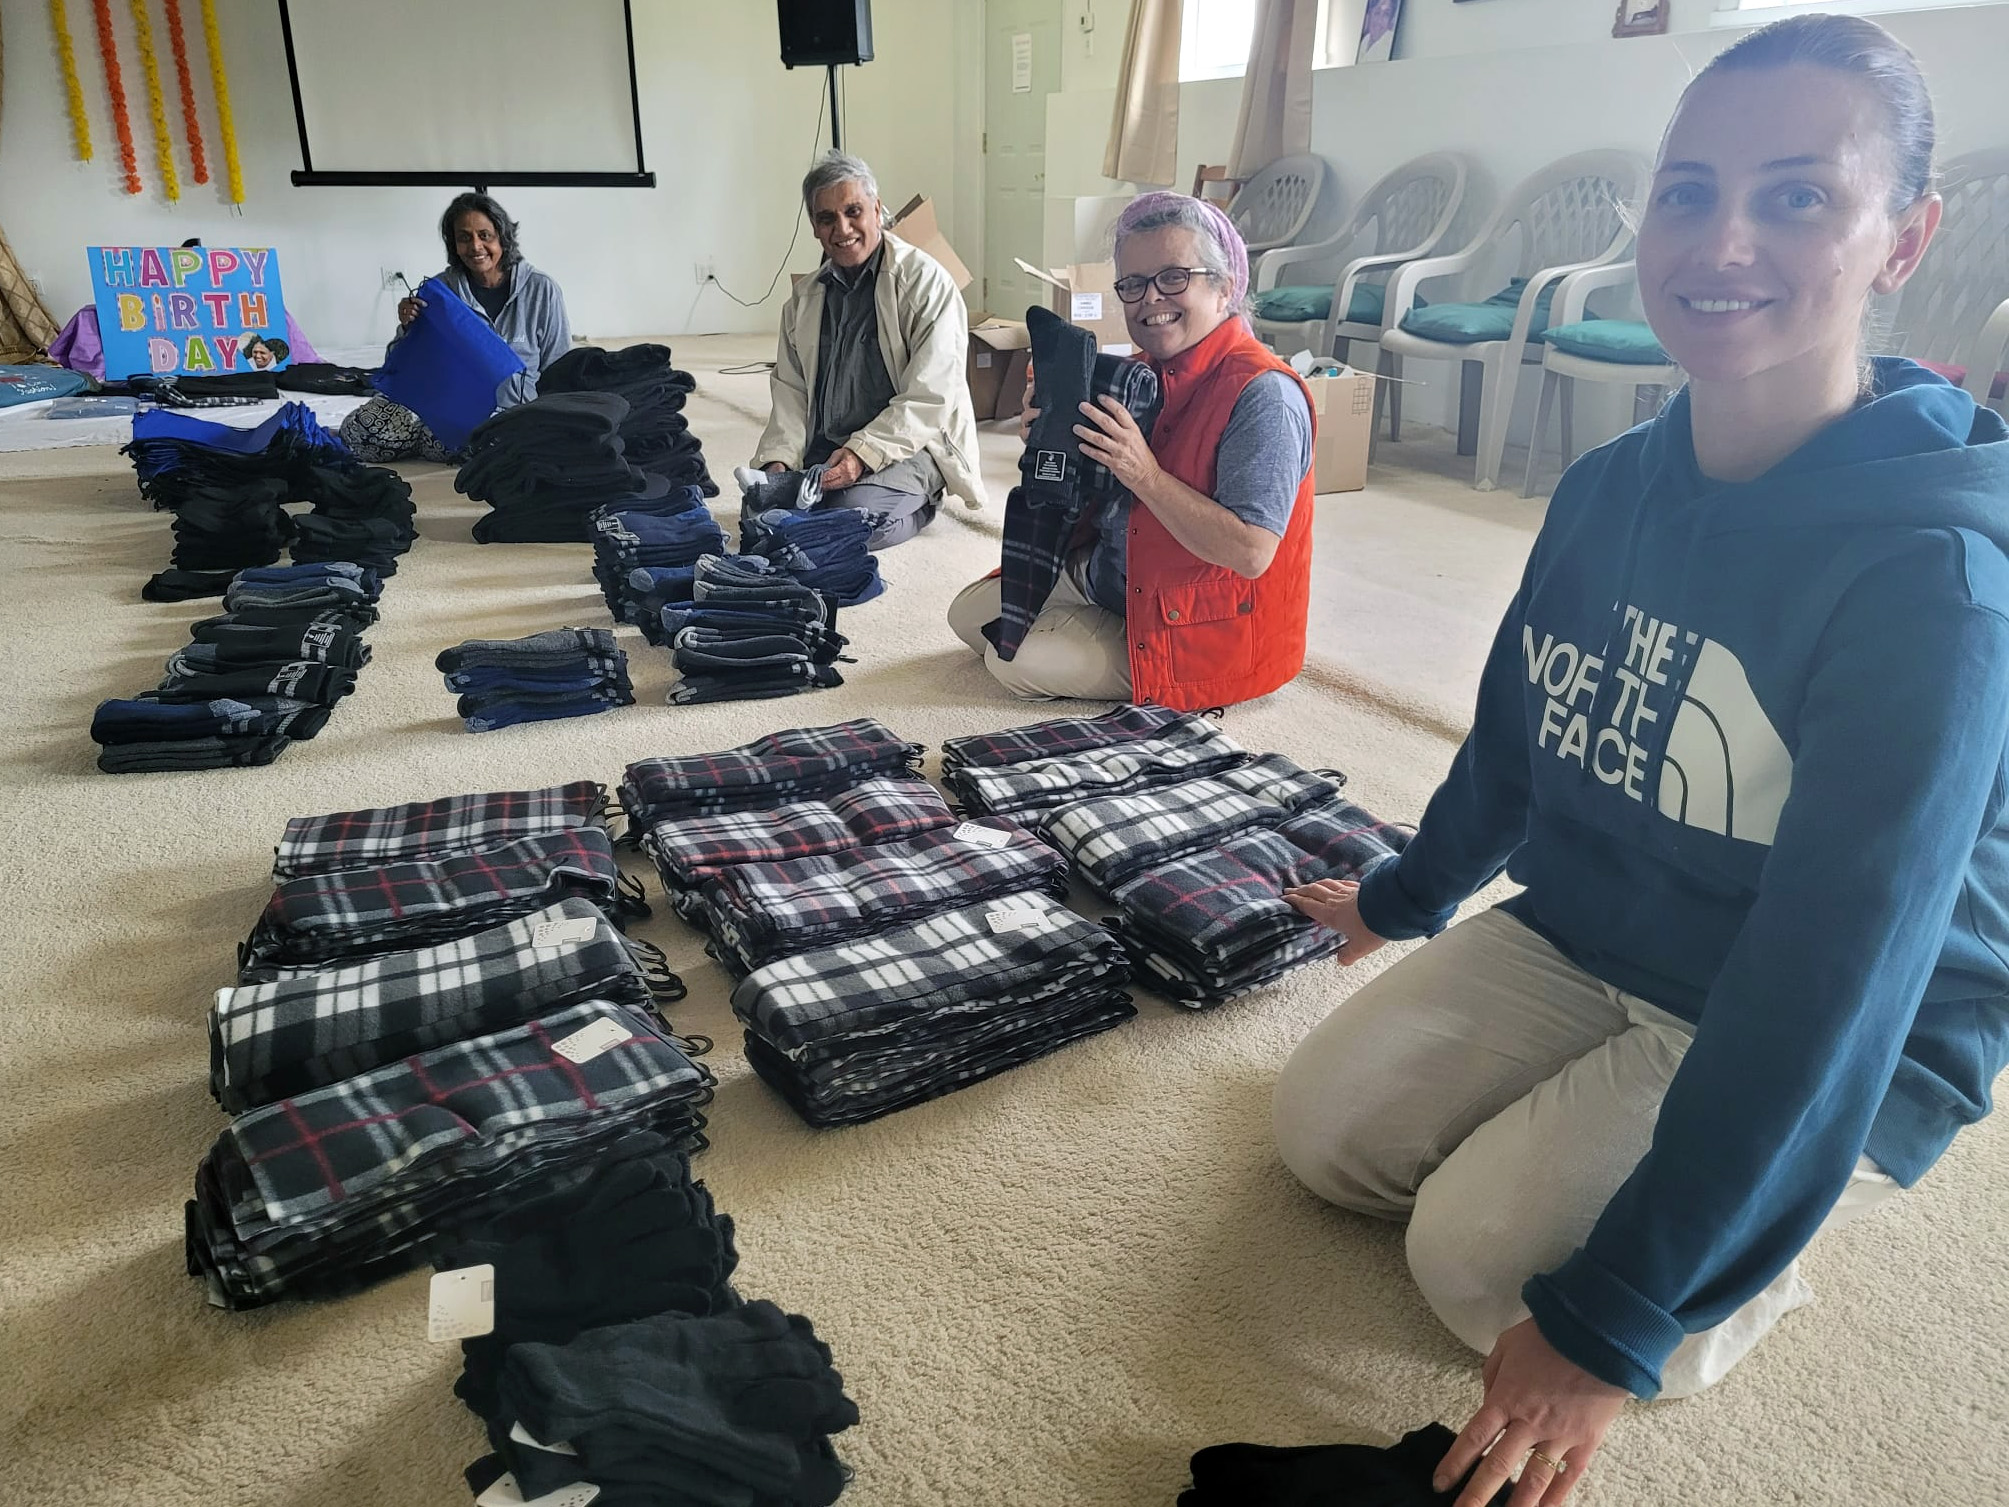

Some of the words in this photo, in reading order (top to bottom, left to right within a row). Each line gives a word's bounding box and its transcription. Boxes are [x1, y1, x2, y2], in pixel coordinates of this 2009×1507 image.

[103, 249, 268, 287] HAPPY
[149, 336, 240, 373] DAY
[1538, 697, 1649, 803] FACE
